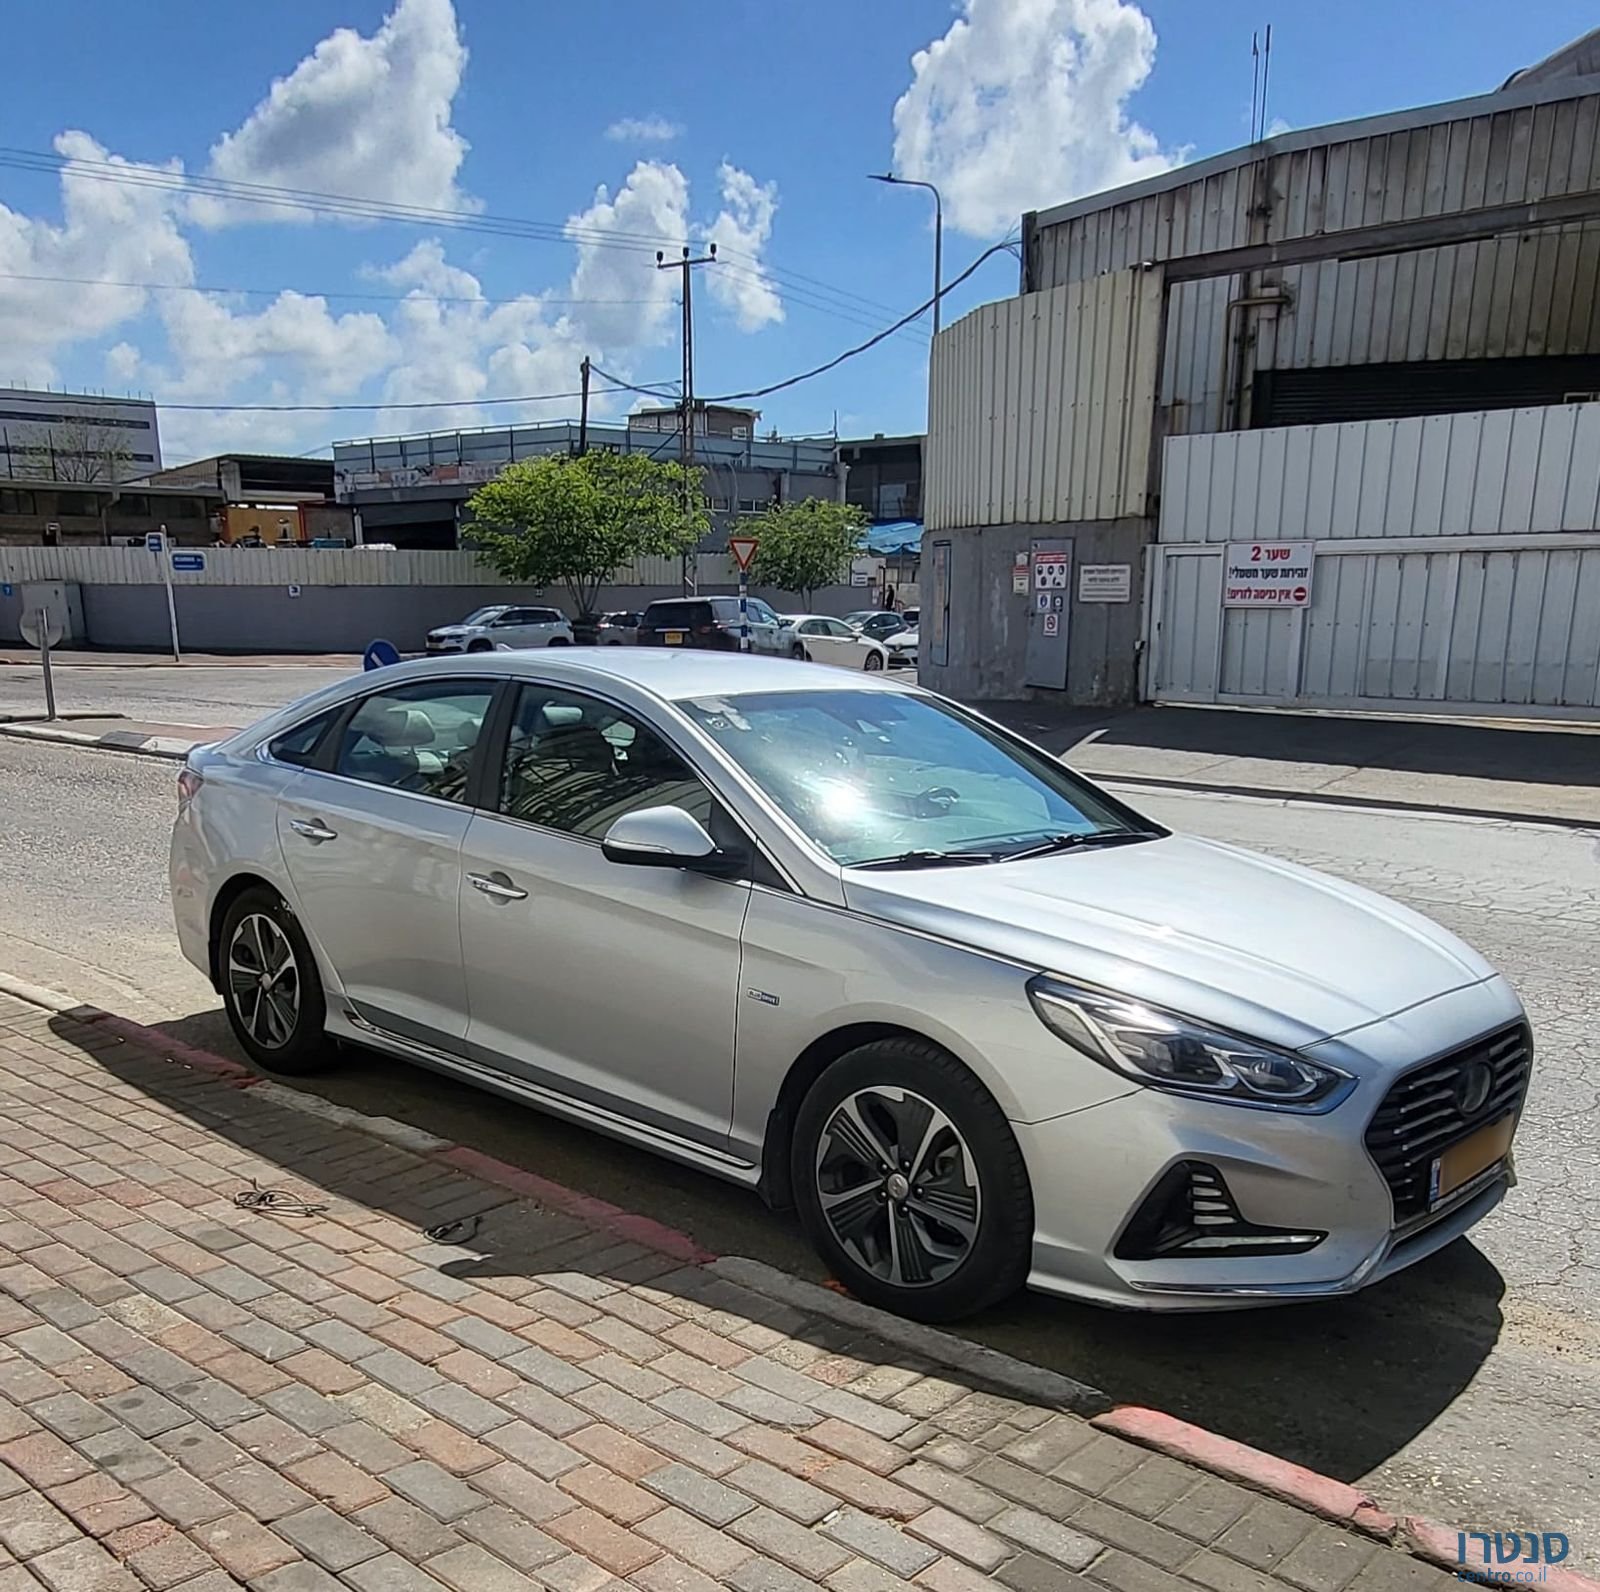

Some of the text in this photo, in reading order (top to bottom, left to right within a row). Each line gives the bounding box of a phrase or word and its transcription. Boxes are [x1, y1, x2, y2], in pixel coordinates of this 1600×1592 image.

[1251, 545, 1290, 561] שער 2
[1228, 565, 1308, 580] זהירות שער חשמלי!
[1253, 589, 1277, 600] כניסה
[1278, 589, 1292, 602] אין
